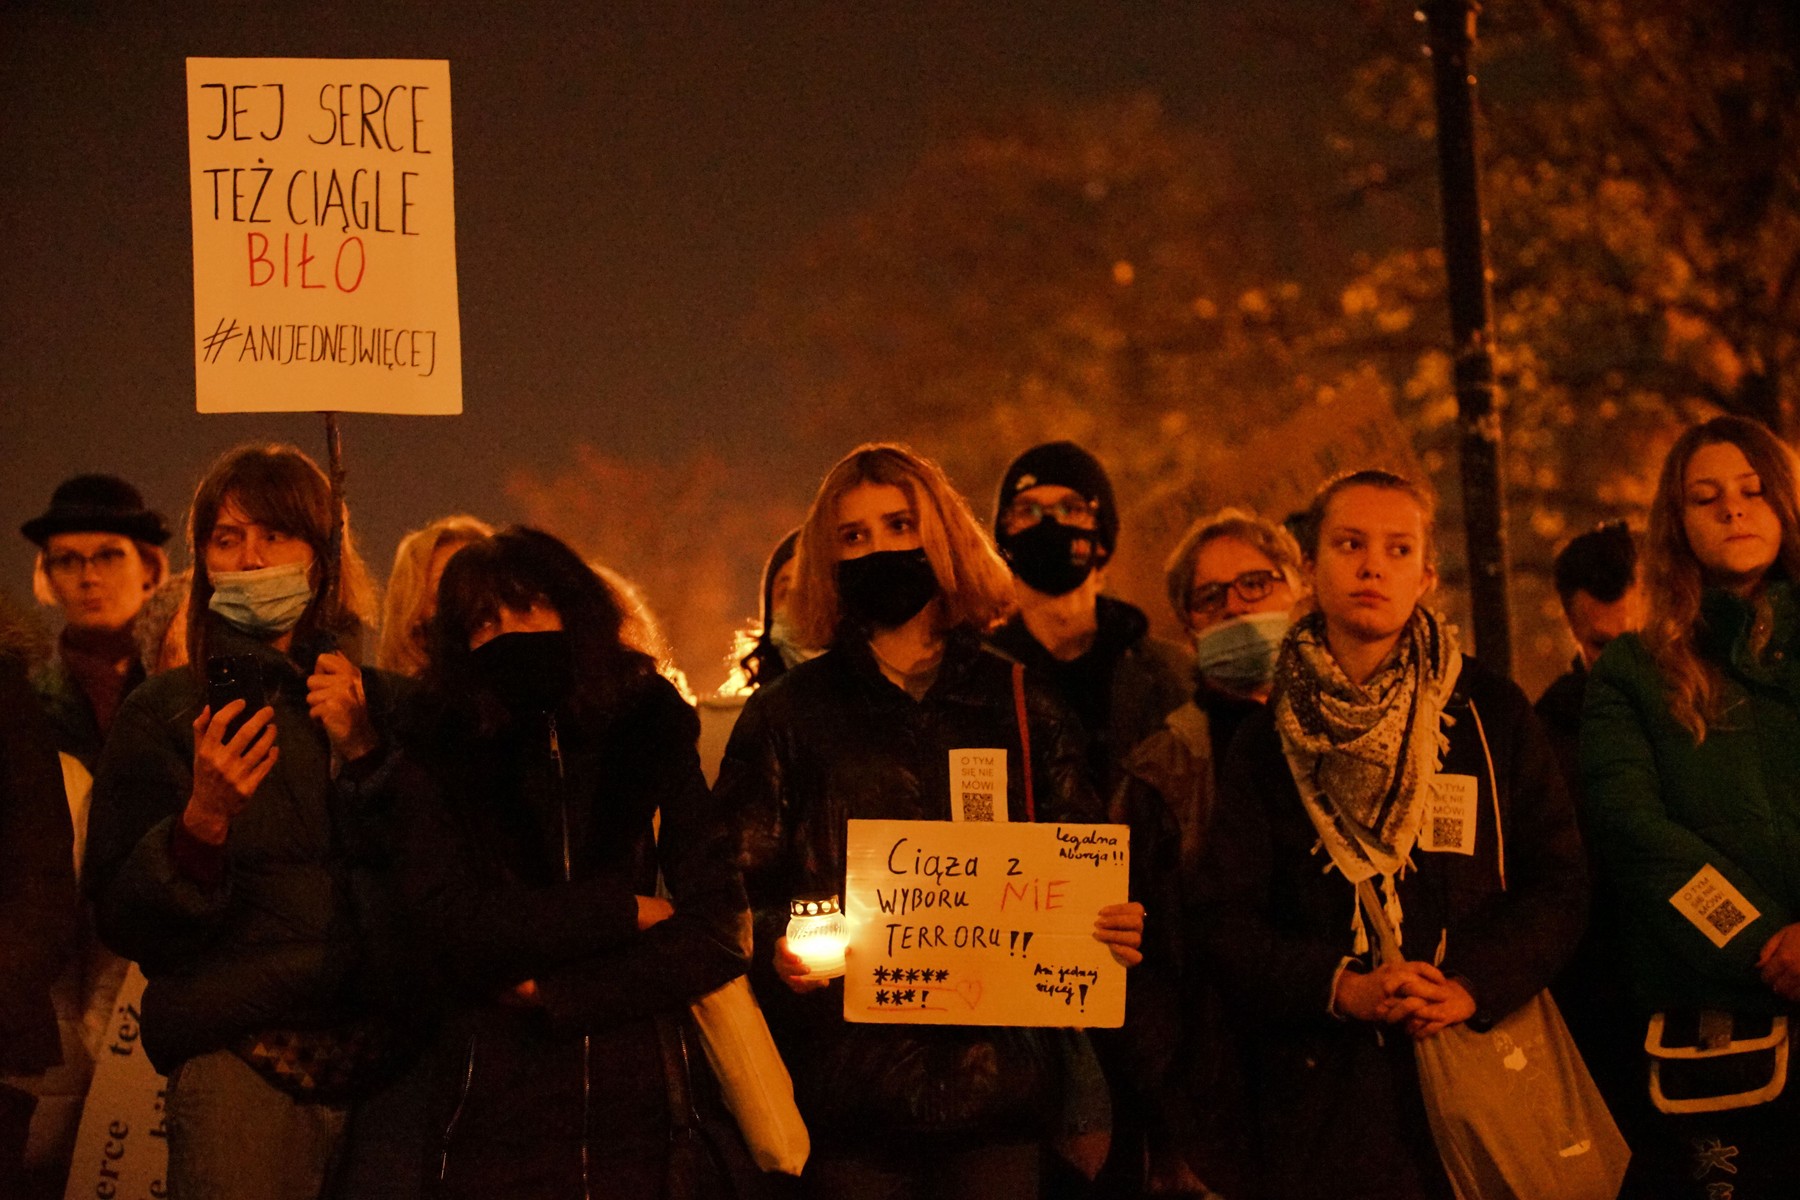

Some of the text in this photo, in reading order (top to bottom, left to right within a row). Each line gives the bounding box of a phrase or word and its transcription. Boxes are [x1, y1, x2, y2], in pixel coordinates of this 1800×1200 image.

[201, 83, 431, 154] JEJ SERCE
[203, 158, 420, 236] TEŻ CIĄGLE
[248, 232, 365, 293] BIŁO
[203, 317, 437, 377] #ANIJEDNEJWIĘCEJ
[973, 757, 994, 765] TYM
[877, 878, 1071, 915] WYBORU NIE
